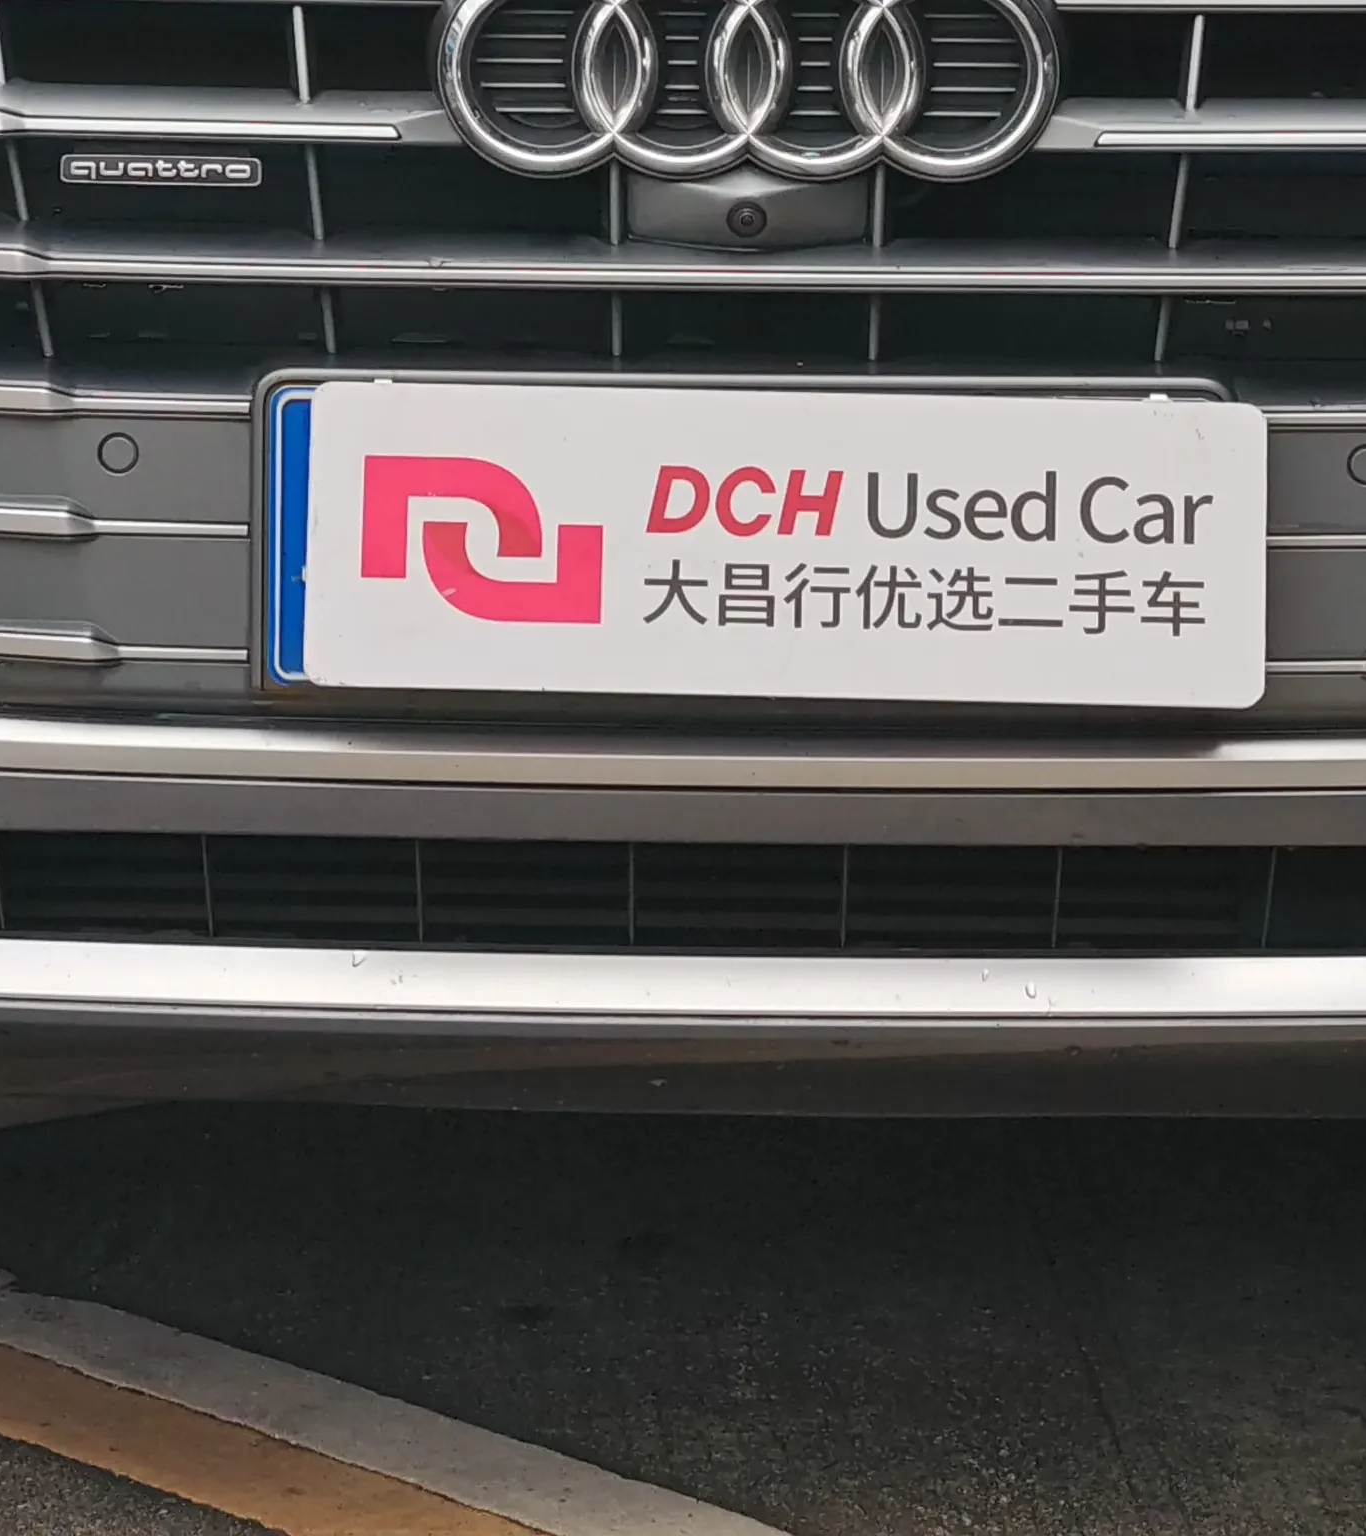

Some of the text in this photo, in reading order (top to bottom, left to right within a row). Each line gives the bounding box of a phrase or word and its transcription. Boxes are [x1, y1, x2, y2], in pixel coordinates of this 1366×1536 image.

[69, 158, 252, 181] quattro
[645, 464, 1214, 545] DCH Used Car
[643, 559, 1207, 637] 大昌行优选二手车
